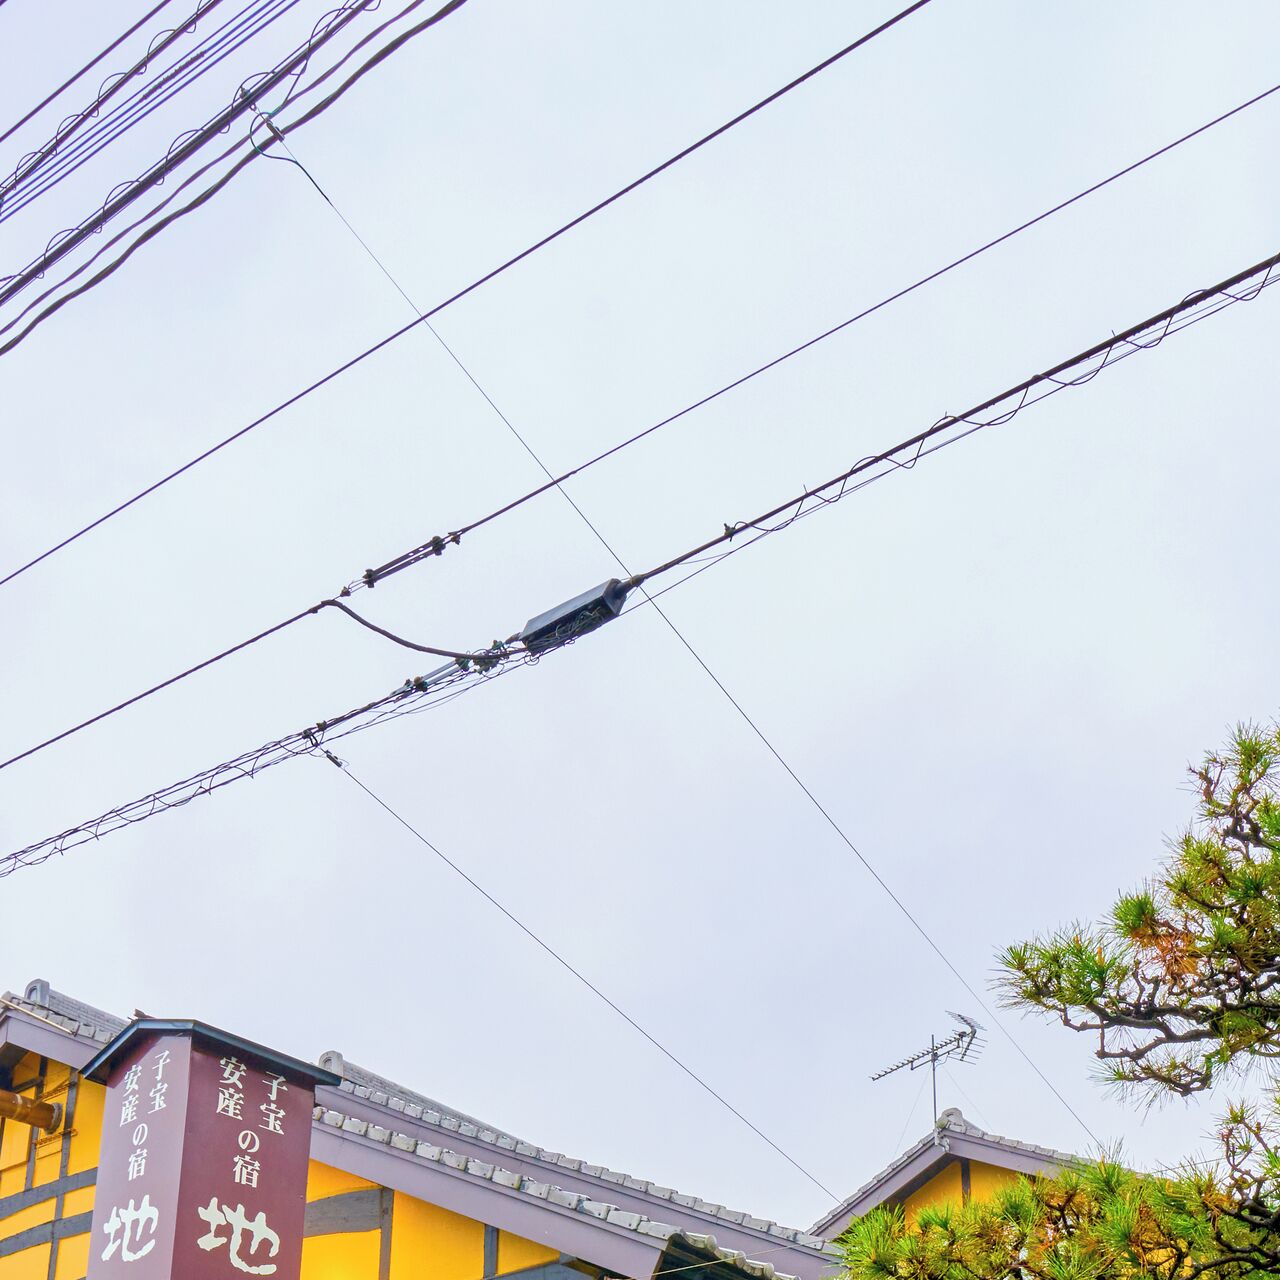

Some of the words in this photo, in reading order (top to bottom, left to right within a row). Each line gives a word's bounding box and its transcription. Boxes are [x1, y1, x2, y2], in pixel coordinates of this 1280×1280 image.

[119, 1065, 143, 1128] 安産
[148, 1050, 171, 1112] 子宝
[216, 1056, 248, 1122] 安産
[258, 1070, 289, 1137] 子宝
[127, 1122, 149, 1182] の宿
[233, 1129, 261, 1188] の宿
